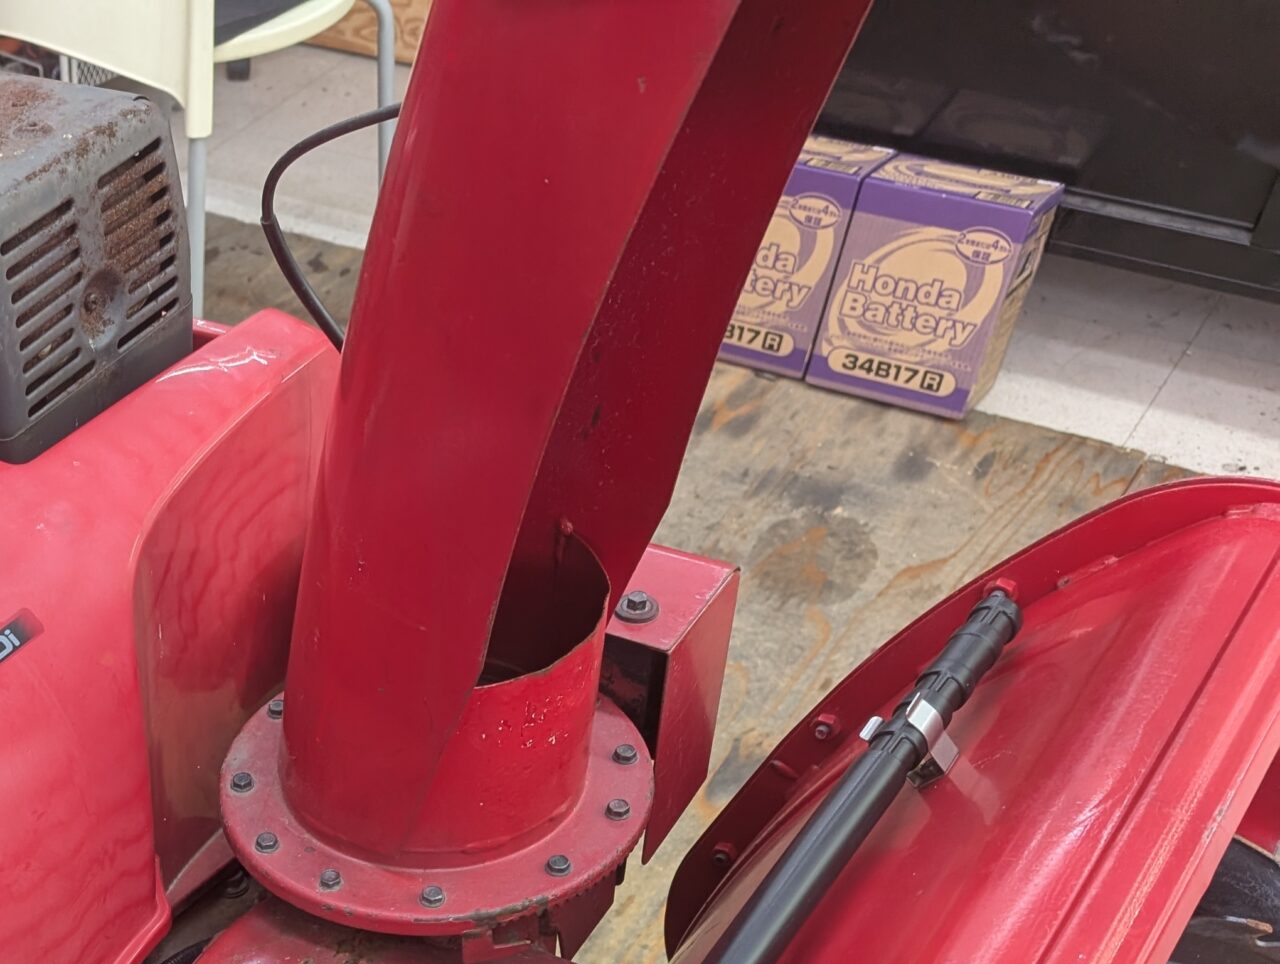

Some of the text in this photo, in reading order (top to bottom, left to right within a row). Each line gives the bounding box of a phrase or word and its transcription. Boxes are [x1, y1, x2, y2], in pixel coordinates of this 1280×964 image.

[743, 268, 812, 309] tery
[847, 262, 962, 312] Honda
[839, 290, 978, 347] Battery
